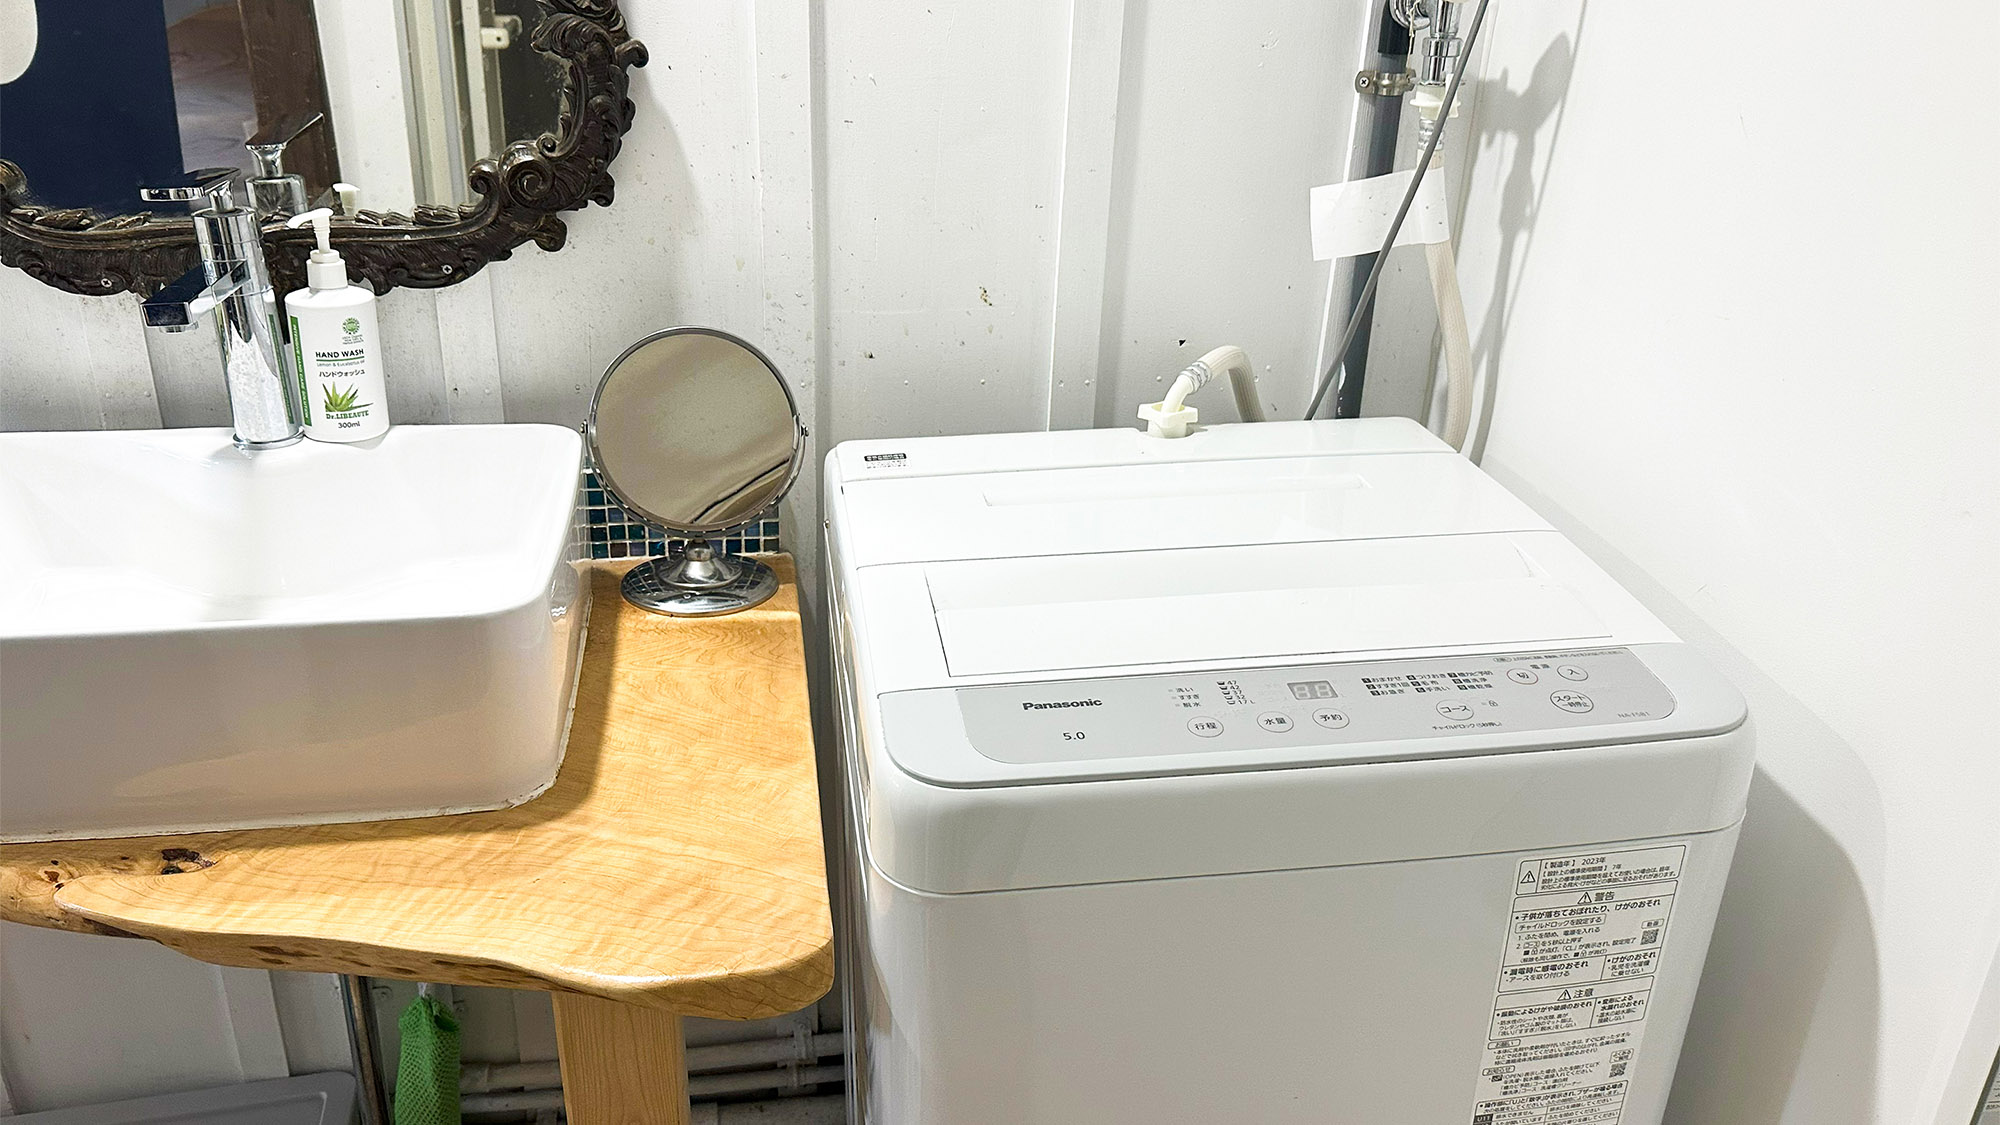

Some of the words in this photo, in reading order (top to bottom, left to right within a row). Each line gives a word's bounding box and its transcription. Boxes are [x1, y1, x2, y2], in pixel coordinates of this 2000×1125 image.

[341, 348, 364, 357] WASH
[319, 369, 366, 378] ハンドウォッシュ
[338, 421, 361, 429] 300ml
[1371, 675, 1402, 683] おまかせ
[1553, 694, 1588, 702] スタート
[1022, 698, 1103, 710] Panasonic
[1439, 705, 1471, 713] コース
[1319, 714, 1343, 722] 予約
[1194, 722, 1218, 730] 行程
[1062, 731, 1086, 741] 5.0
[1581, 856, 1607, 866] 2023年
[1594, 891, 1615, 902] 警告
[1518, 916, 1602, 932] チャイルドロックを設定する
[1610, 951, 1656, 964] けがのおそれ
[1509, 970, 1570, 983] アースを取り付ける
[1573, 988, 1594, 999] 注意
